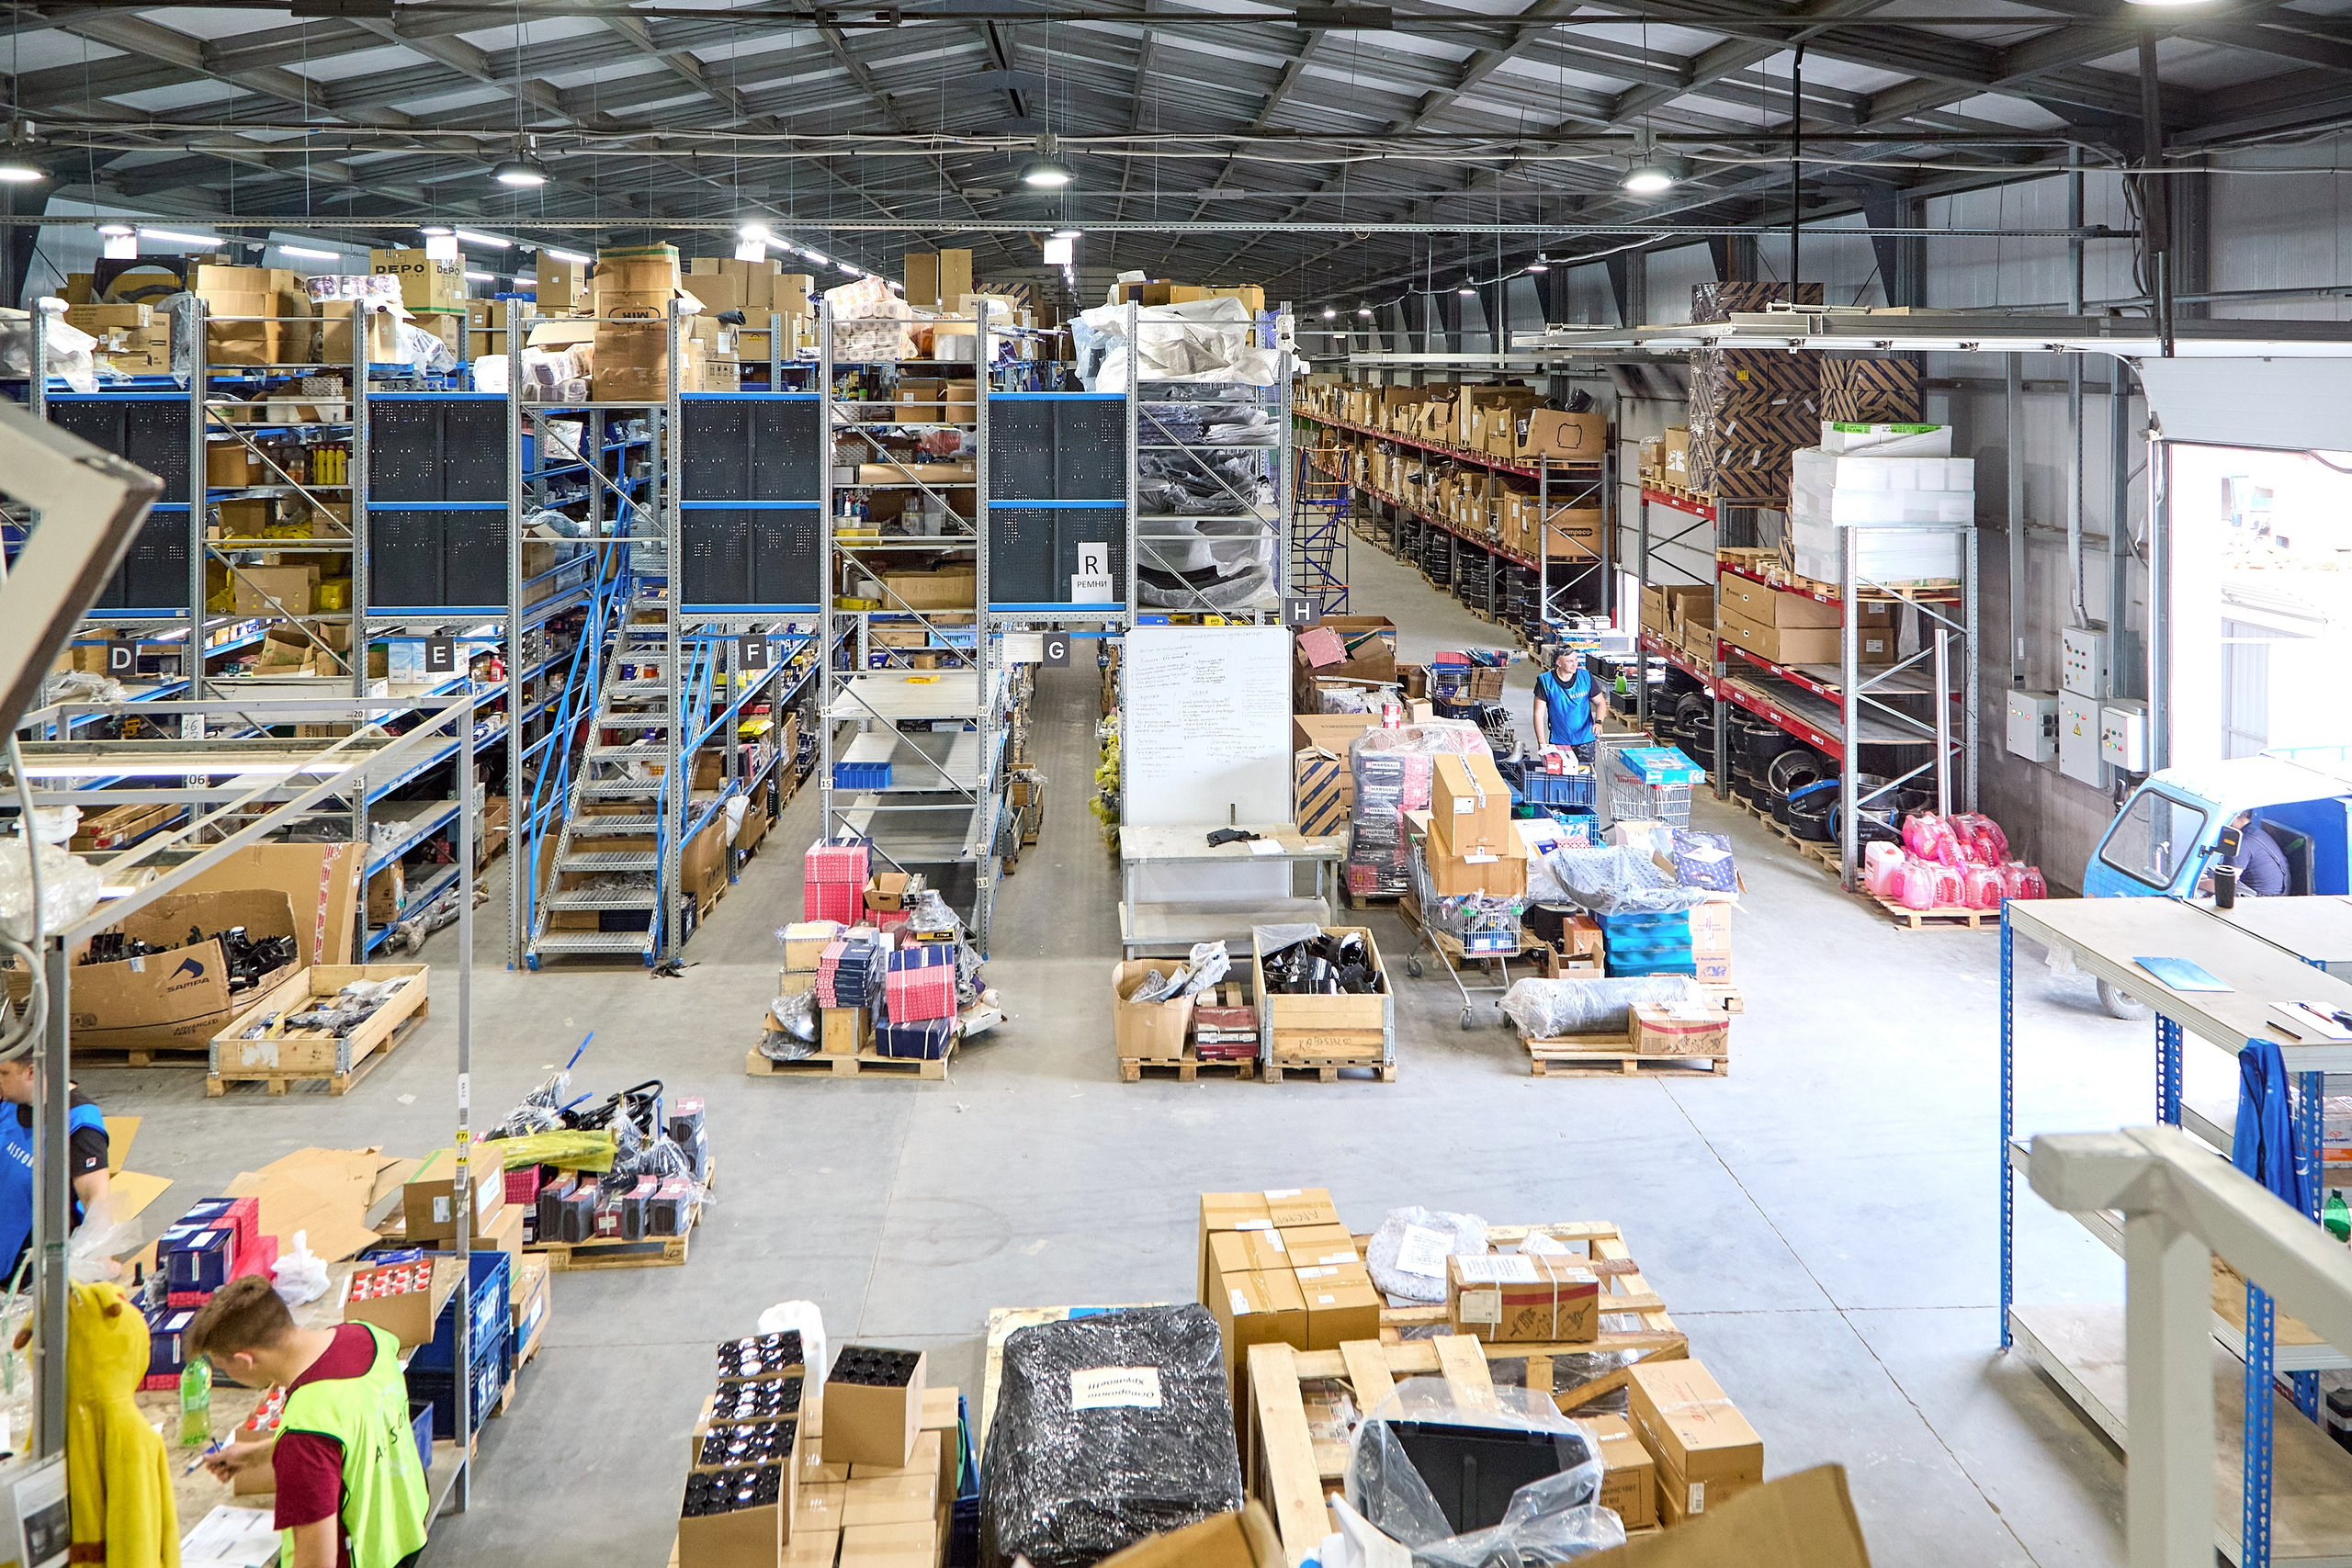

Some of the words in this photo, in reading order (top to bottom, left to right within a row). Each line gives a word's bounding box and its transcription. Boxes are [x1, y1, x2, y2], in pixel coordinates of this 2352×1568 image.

[375, 264, 424, 274] DEPO
[436, 265, 460, 276] DEPO
[1085, 555, 1099, 575] R
[1077, 580, 1107, 589] РЕМНИ
[1295, 602, 1310, 621] H
[433, 646, 447, 664] E
[747, 643, 760, 661] F
[1048, 641, 1065, 660] G
[111, 647, 132, 670] D
[354, 710, 364, 718] 20
[821, 707, 831, 716] 14
[188, 774, 206, 784] 06
[821, 780, 831, 788] 15
[977, 845, 986, 853] 12
[166, 977, 210, 993] SAMPA
[175, 1019, 219, 1032] ADVANCED
[1088, 1377, 1145, 1391] Хрупкое!!!
[1088, 1389, 1155, 1399] Осторожно
